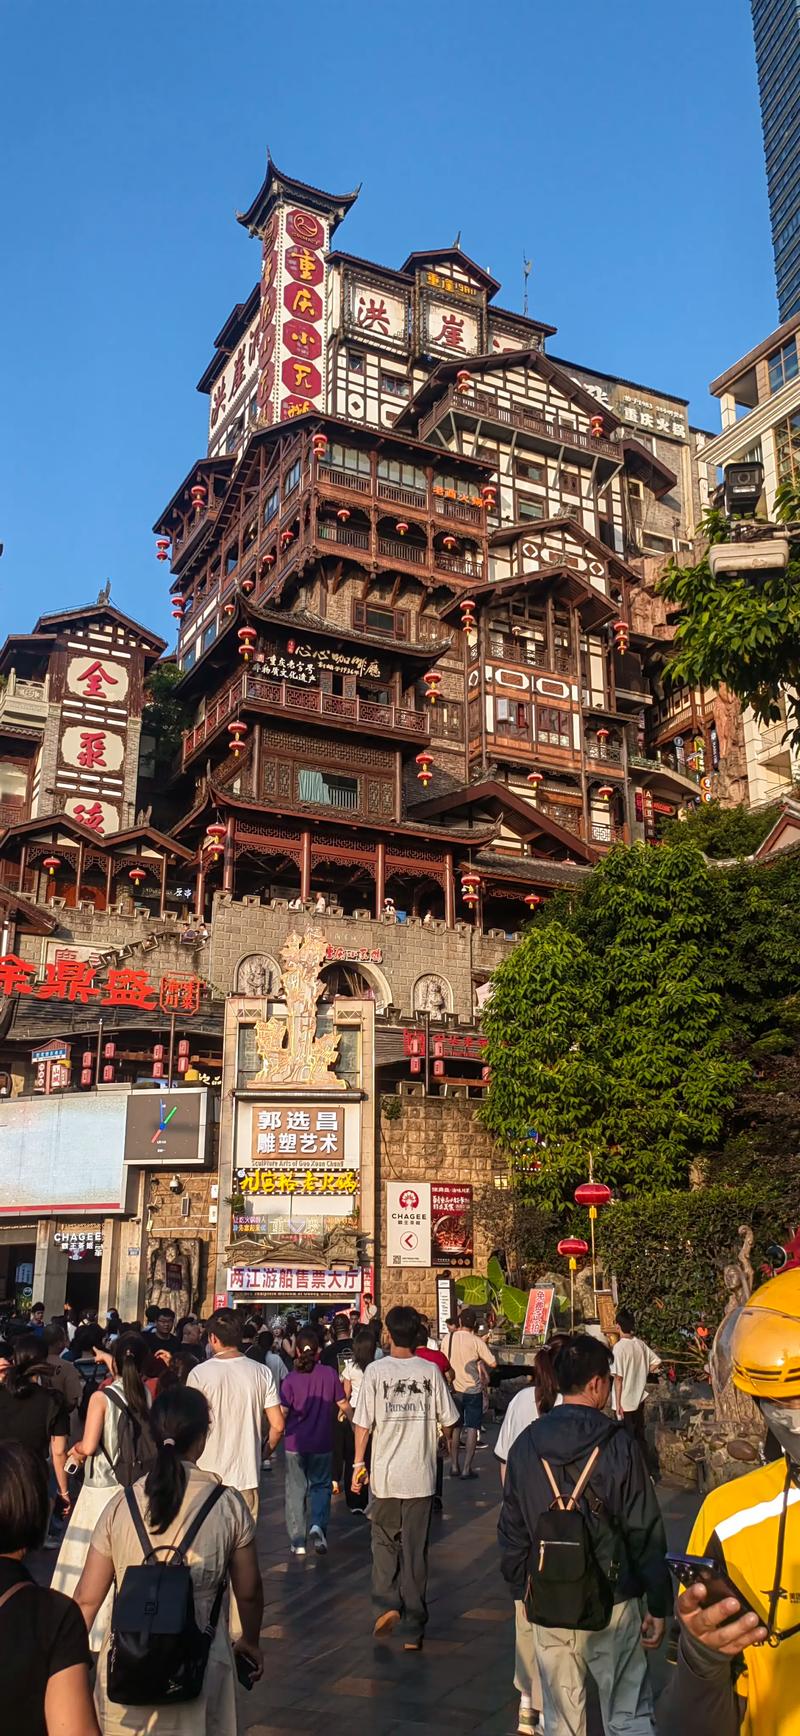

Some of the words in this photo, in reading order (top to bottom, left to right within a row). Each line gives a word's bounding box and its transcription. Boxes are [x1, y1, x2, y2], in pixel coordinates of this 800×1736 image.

[624, 407, 686, 438] 重庆火锅
[252, 663, 317, 683] 非物质文化遗产
[267, 654, 315, 675] 重庆老字号
[257, 1111, 338, 1131] 郭选昌
[257, 1133, 338, 1153] 雕塑艺术
[240, 1169, 356, 1192] 九宫格老火锅
[54, 1232, 102, 1242] CHAGEE
[230, 1268, 358, 1289] 两江游船售票大厅
